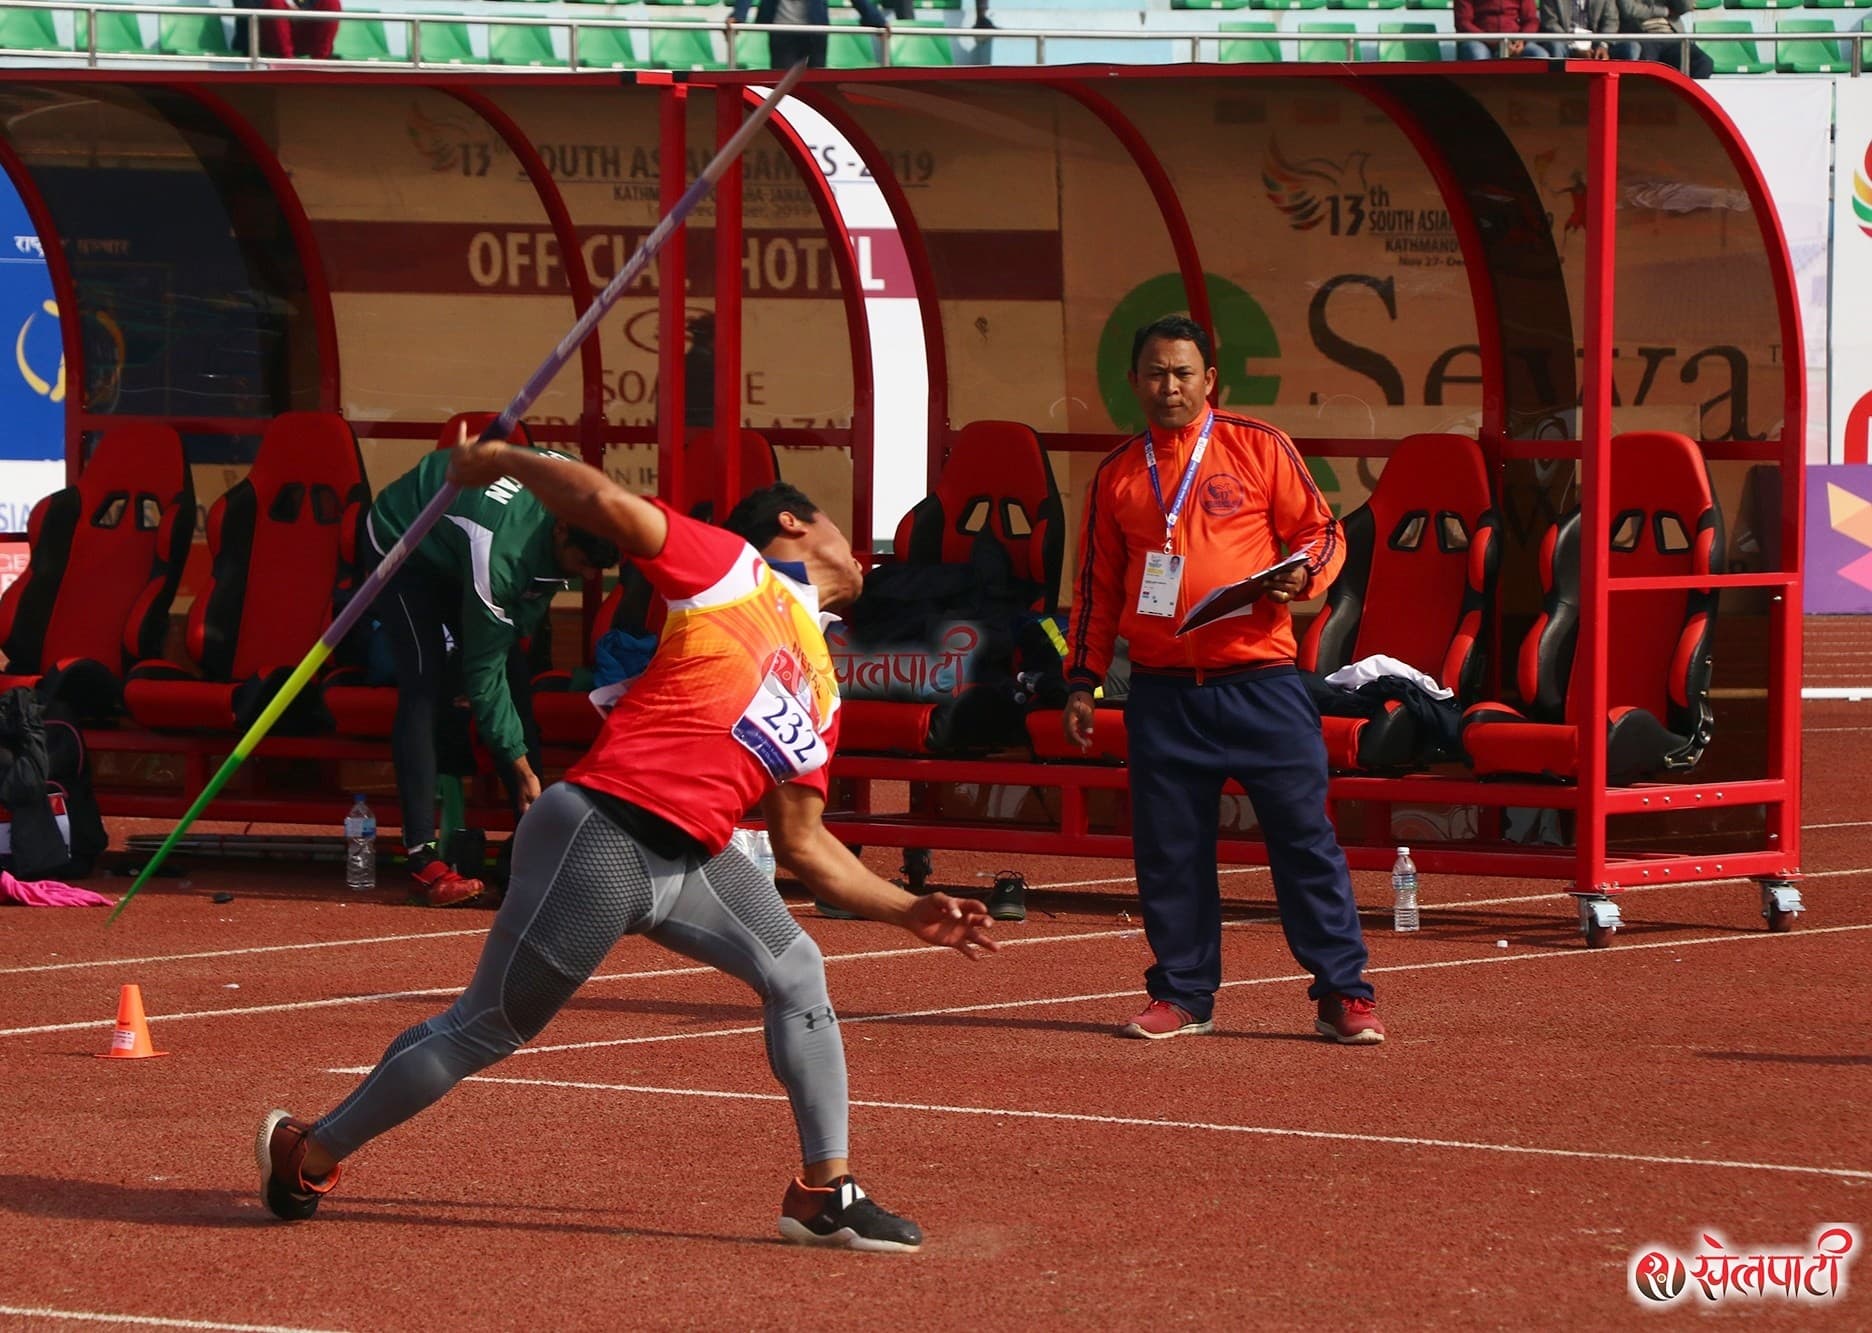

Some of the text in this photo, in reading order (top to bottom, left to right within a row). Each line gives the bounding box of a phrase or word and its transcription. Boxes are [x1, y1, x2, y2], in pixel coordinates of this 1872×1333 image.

[519, 146, 622, 178] OUTH
[740, 146, 837, 183] GAMS
[1368, 210, 1414, 232] SOUTH
[468, 231, 885, 291] OFFCIA HOTL
[1308, 274, 1767, 441] Sewa
[761, 695, 816, 764] 232
